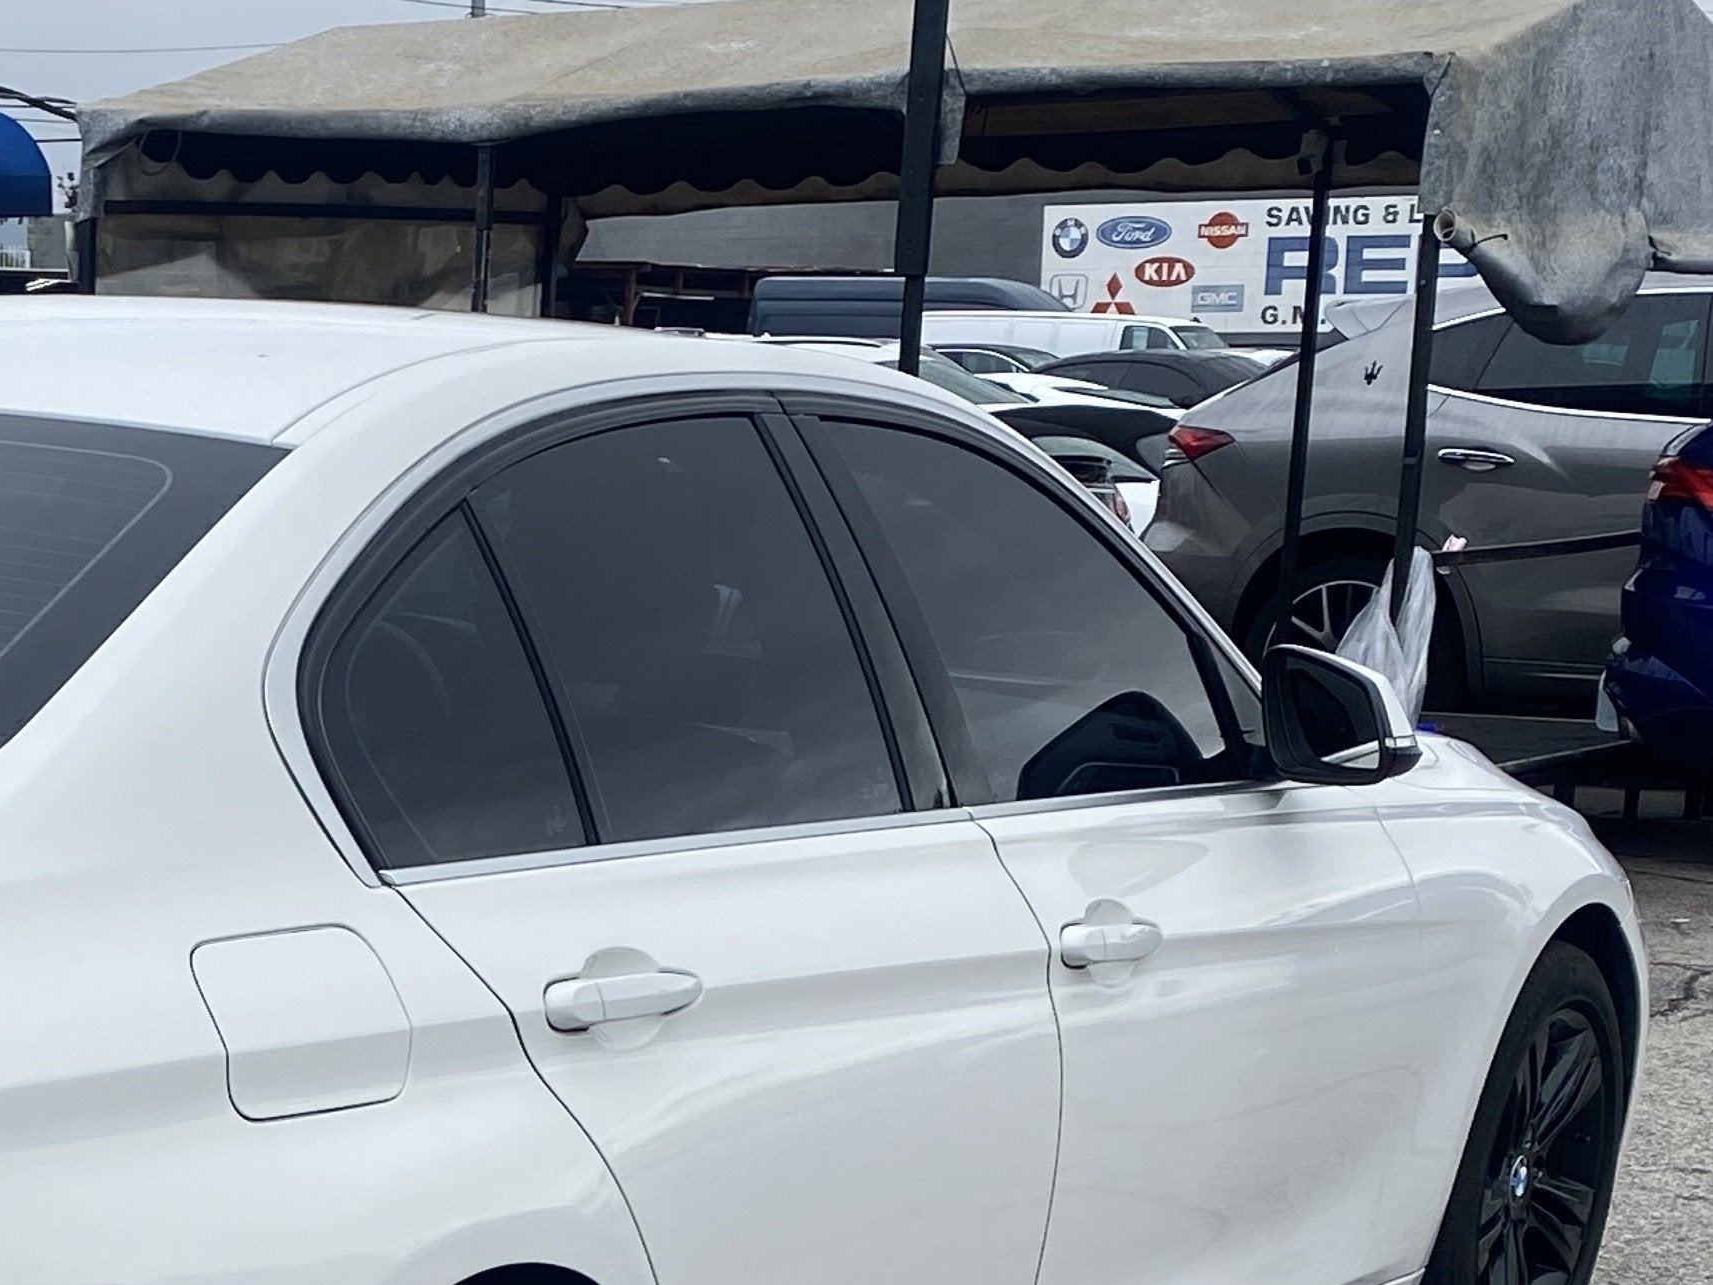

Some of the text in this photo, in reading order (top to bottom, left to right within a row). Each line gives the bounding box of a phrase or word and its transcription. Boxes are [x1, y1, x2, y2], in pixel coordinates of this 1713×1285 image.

[1265, 204, 1370, 227] SAVNG
[1382, 204, 1399, 224] &
[1111, 221, 1155, 242] Ford
[1199, 224, 1247, 237] NISSAN
[1143, 262, 1187, 281] KIA
[1197, 291, 1238, 305] GMC
